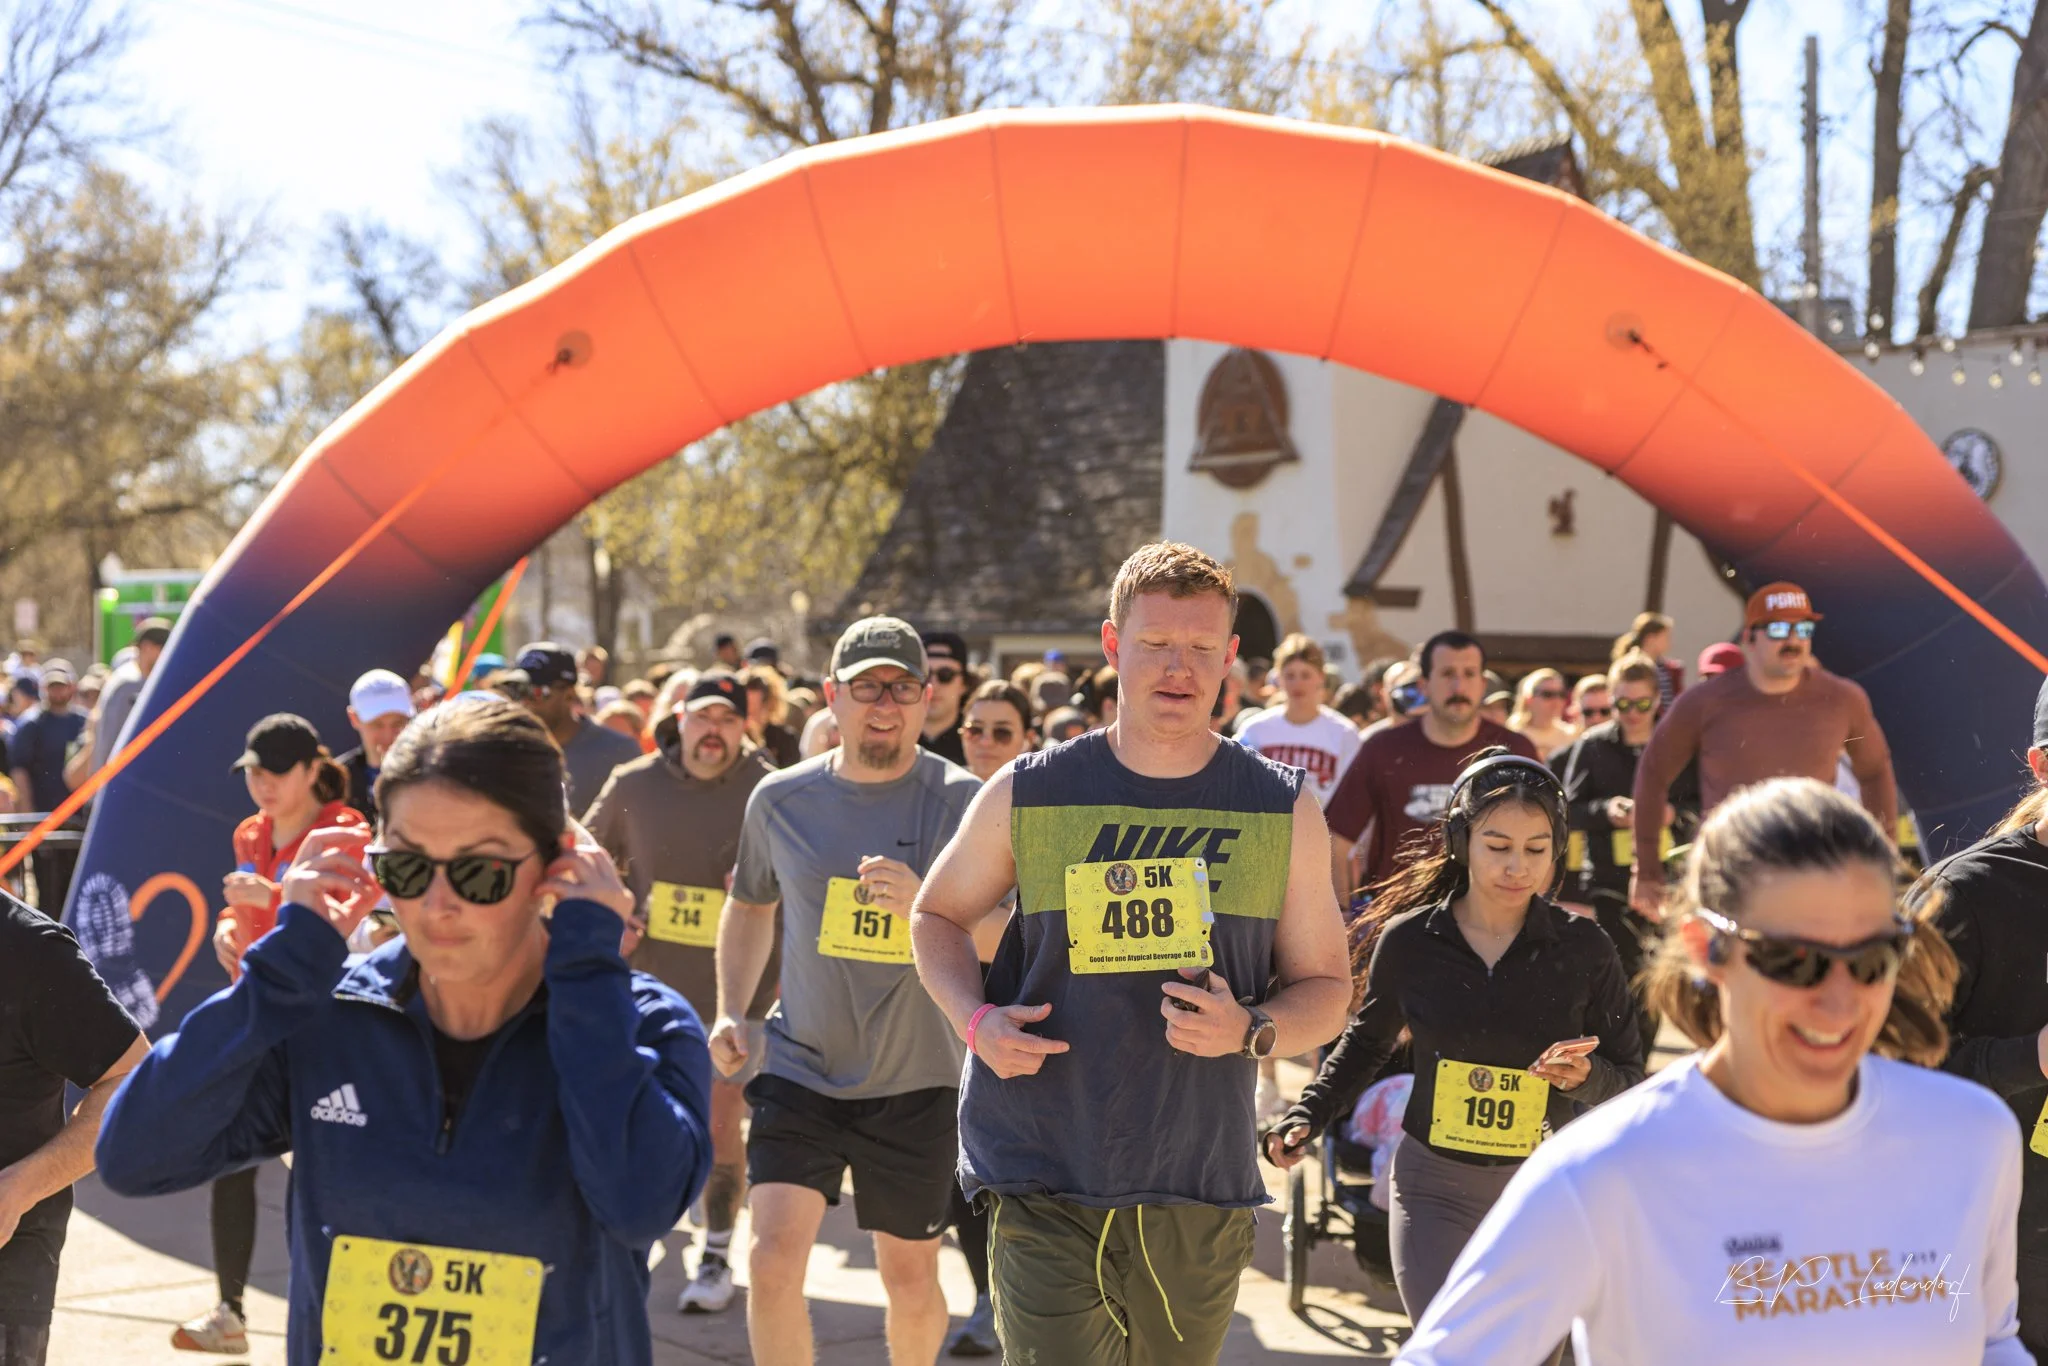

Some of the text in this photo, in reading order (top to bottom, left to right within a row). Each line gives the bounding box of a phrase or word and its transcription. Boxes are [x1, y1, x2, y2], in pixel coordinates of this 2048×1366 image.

[1085, 824, 1242, 893] NIKE
[1144, 865, 1173, 888] 5K
[669, 906, 701, 927] 214
[852, 909, 892, 940] 151
[1102, 898, 1174, 940] 488
[1089, 955, 1105, 963] Good
[1105, 955, 1114, 963] for
[1127, 953, 1152, 962] Atypical
[1153, 952, 1182, 961] Beverage
[1183, 951, 1196, 959] 488
[1500, 1073, 1521, 1092] 5K
[310, 1105, 368, 1127] adidas
[1464, 1096, 1515, 1131] 199
[444, 1260, 487, 1296] 5K
[1732, 1273, 1946, 1321] MARATHON
[374, 1302, 473, 1366] 375
